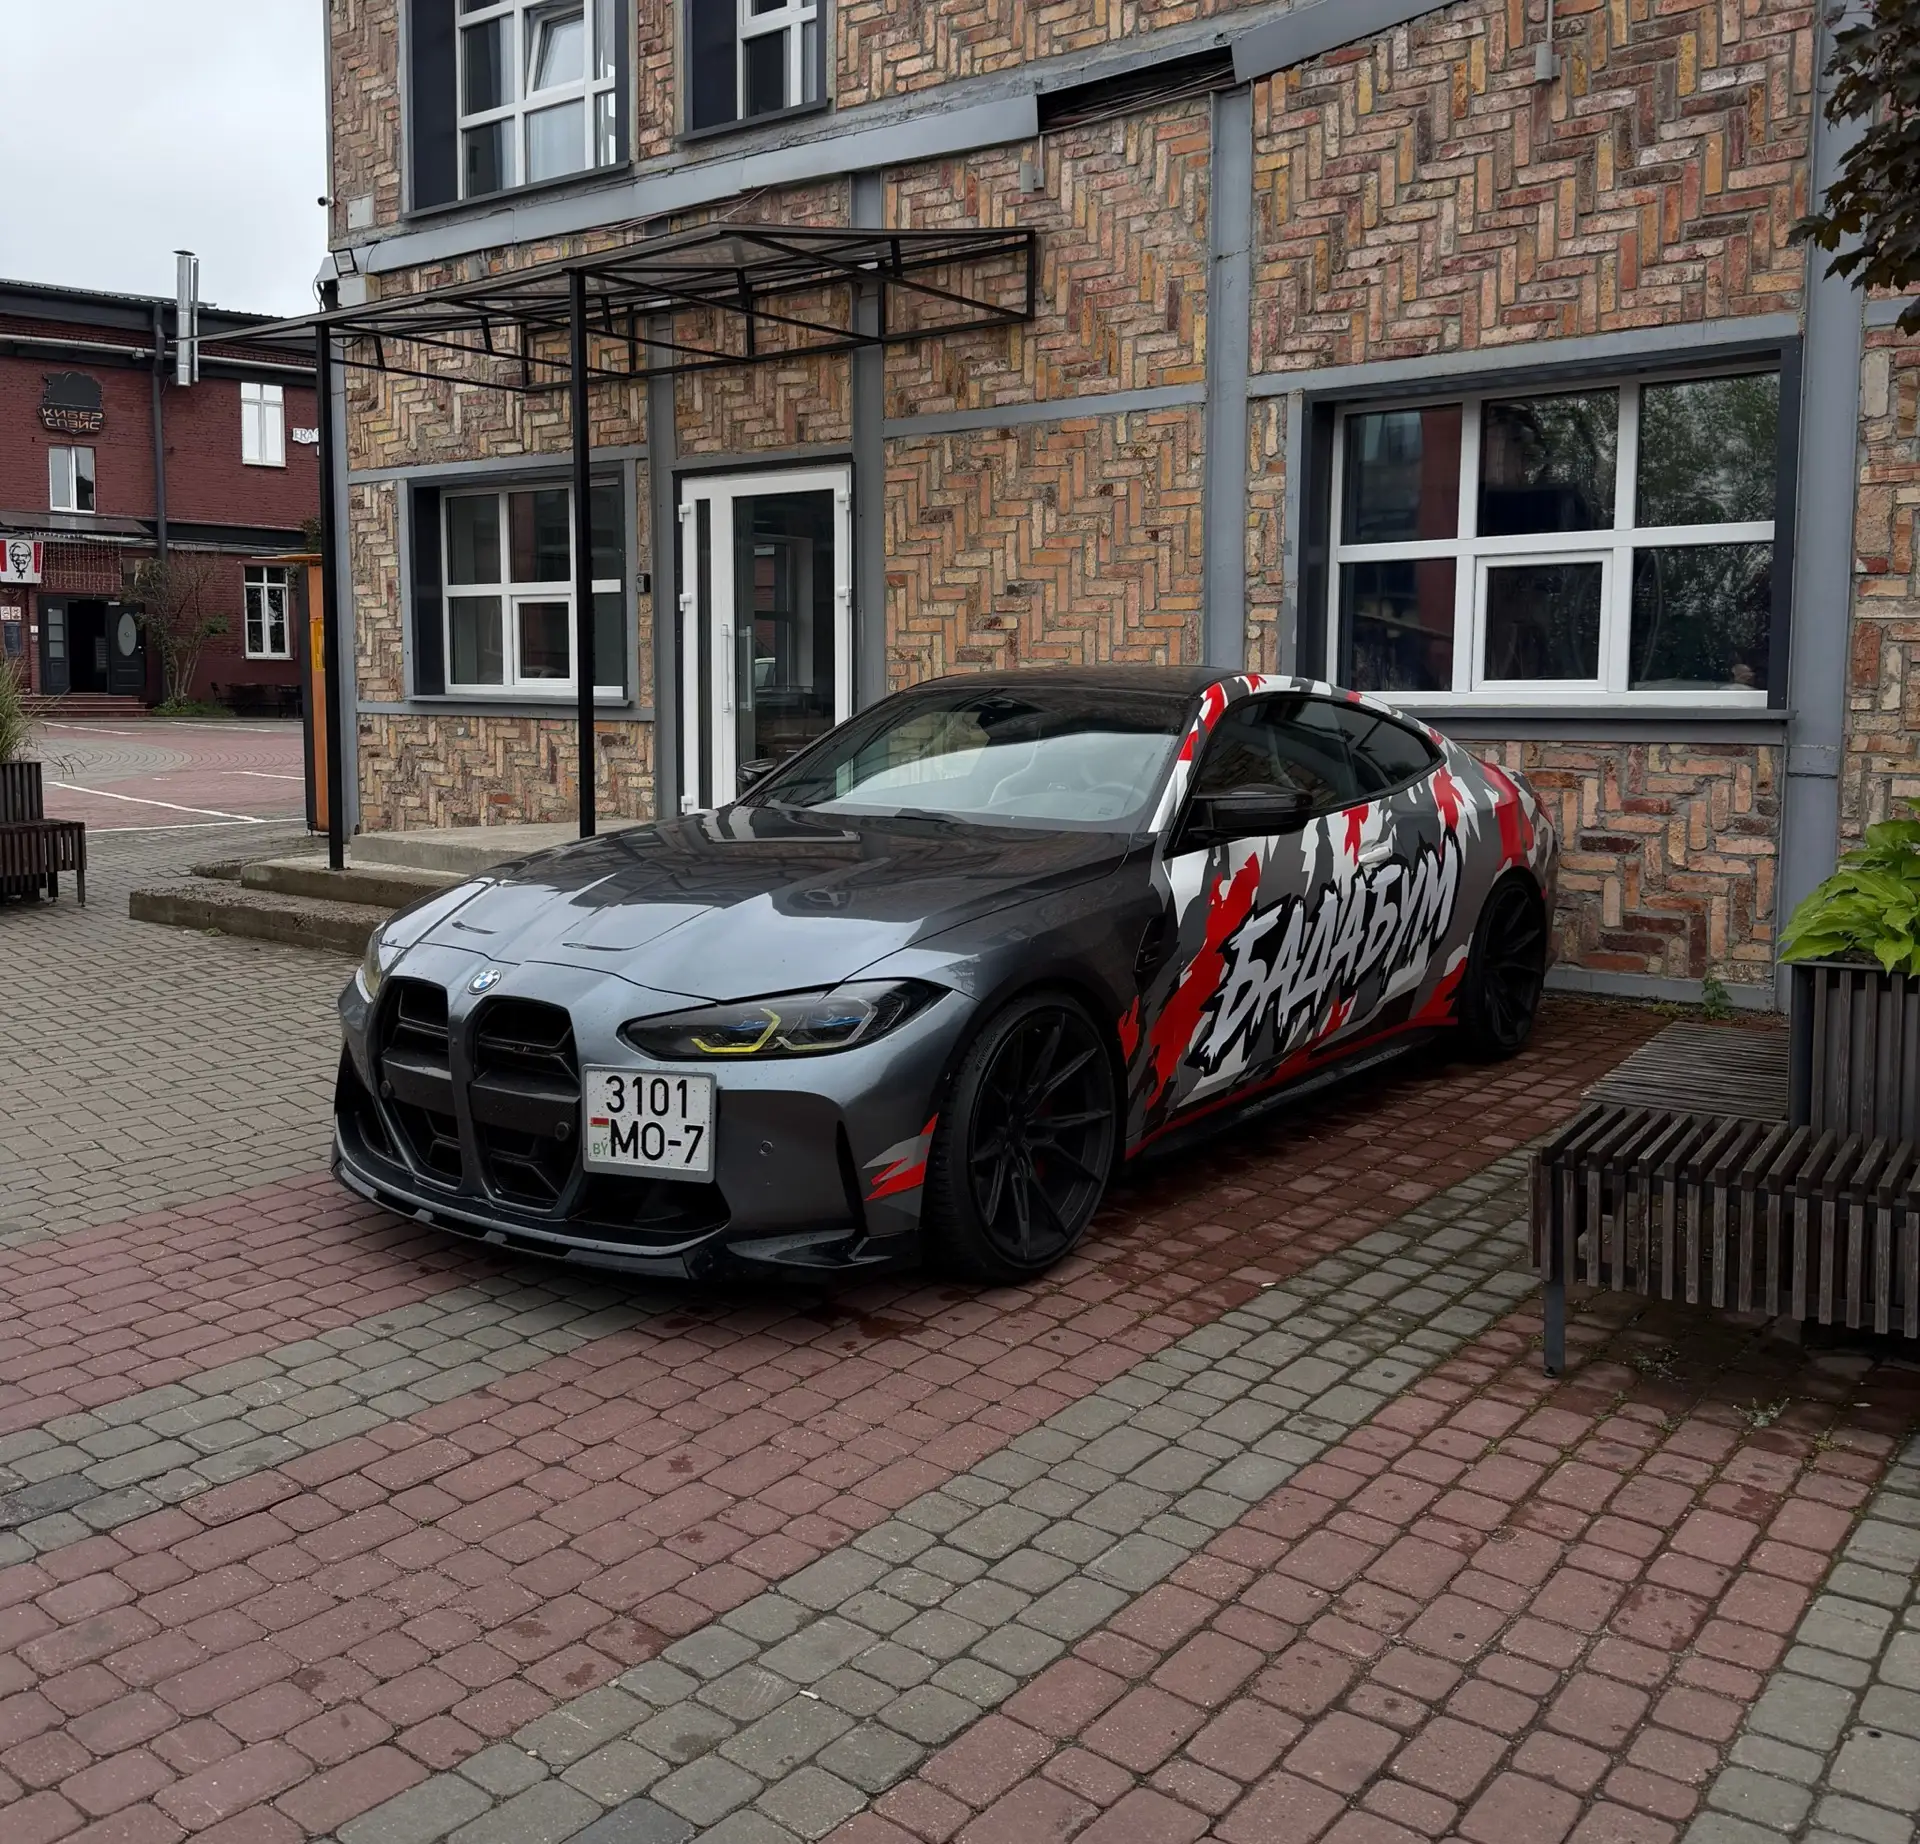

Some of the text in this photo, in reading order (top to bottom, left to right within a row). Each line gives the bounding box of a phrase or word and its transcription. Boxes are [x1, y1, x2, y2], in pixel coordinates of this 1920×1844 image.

[42, 407, 103, 421] КИБЕР
[1196, 832, 1461, 1069] БАДАБУМ
[606, 1075, 687, 1119] 3101
[593, 1142, 608, 1156] BY
[610, 1118, 704, 1164] MO-7
